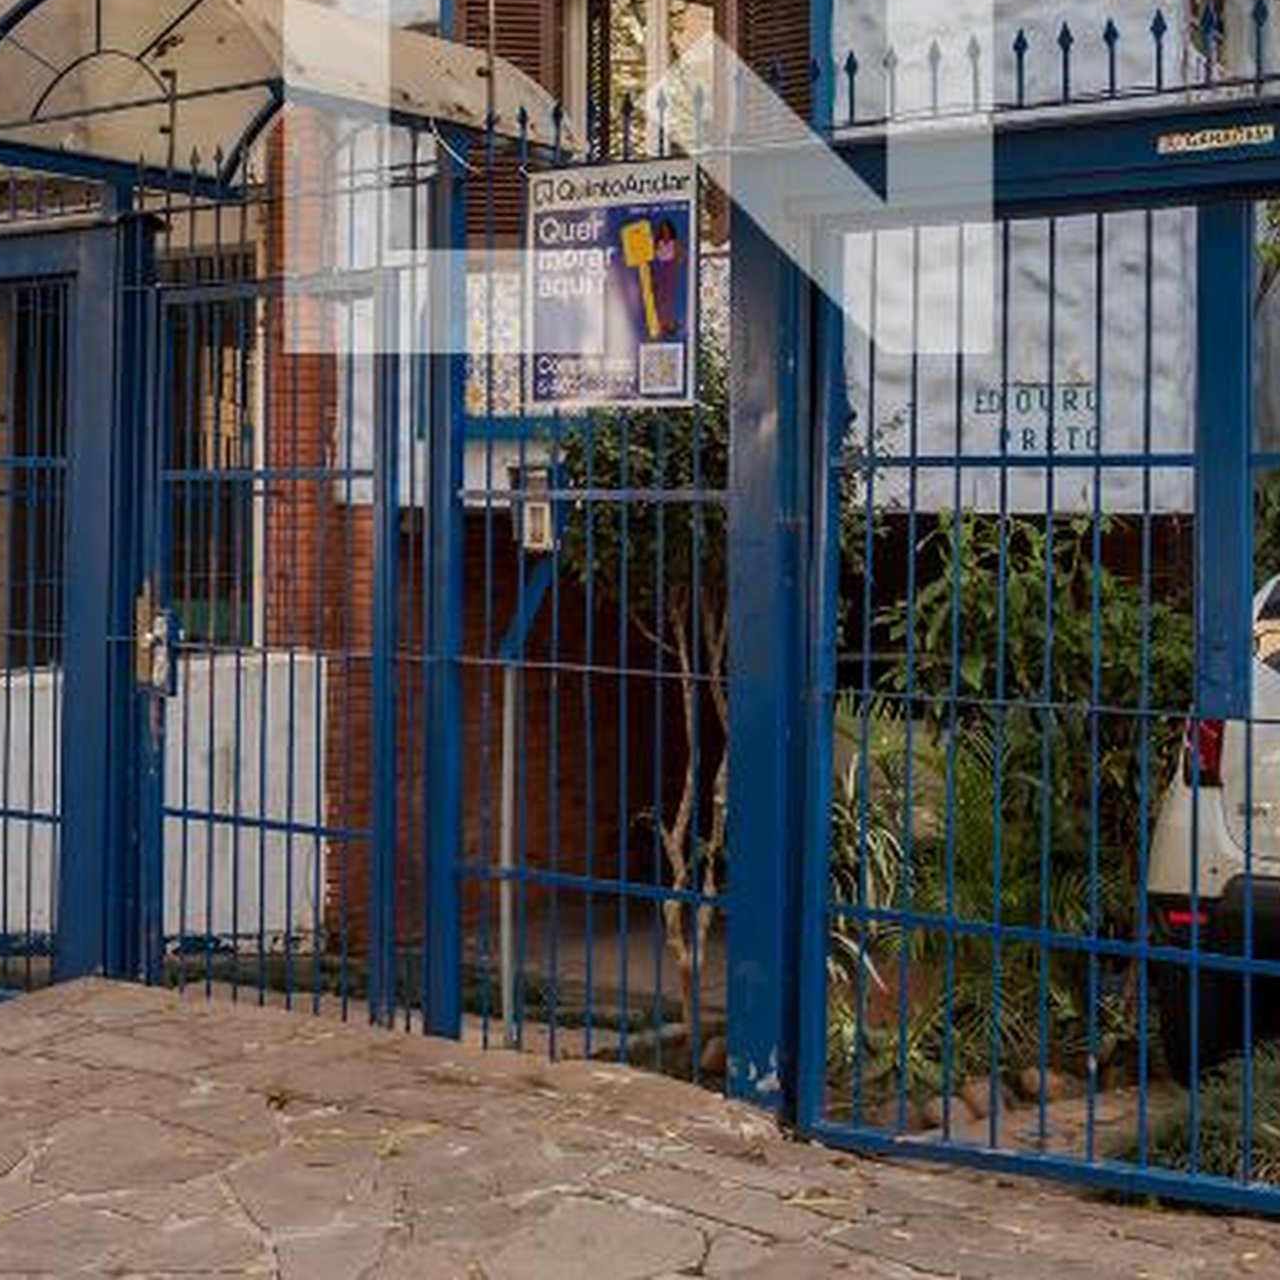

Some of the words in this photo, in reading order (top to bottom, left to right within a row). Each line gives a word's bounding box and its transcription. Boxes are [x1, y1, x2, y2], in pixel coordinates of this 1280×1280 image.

[539, 217, 604, 244] Quer
[539, 246, 618, 273] morar
[1001, 426, 1100, 451] RTO
